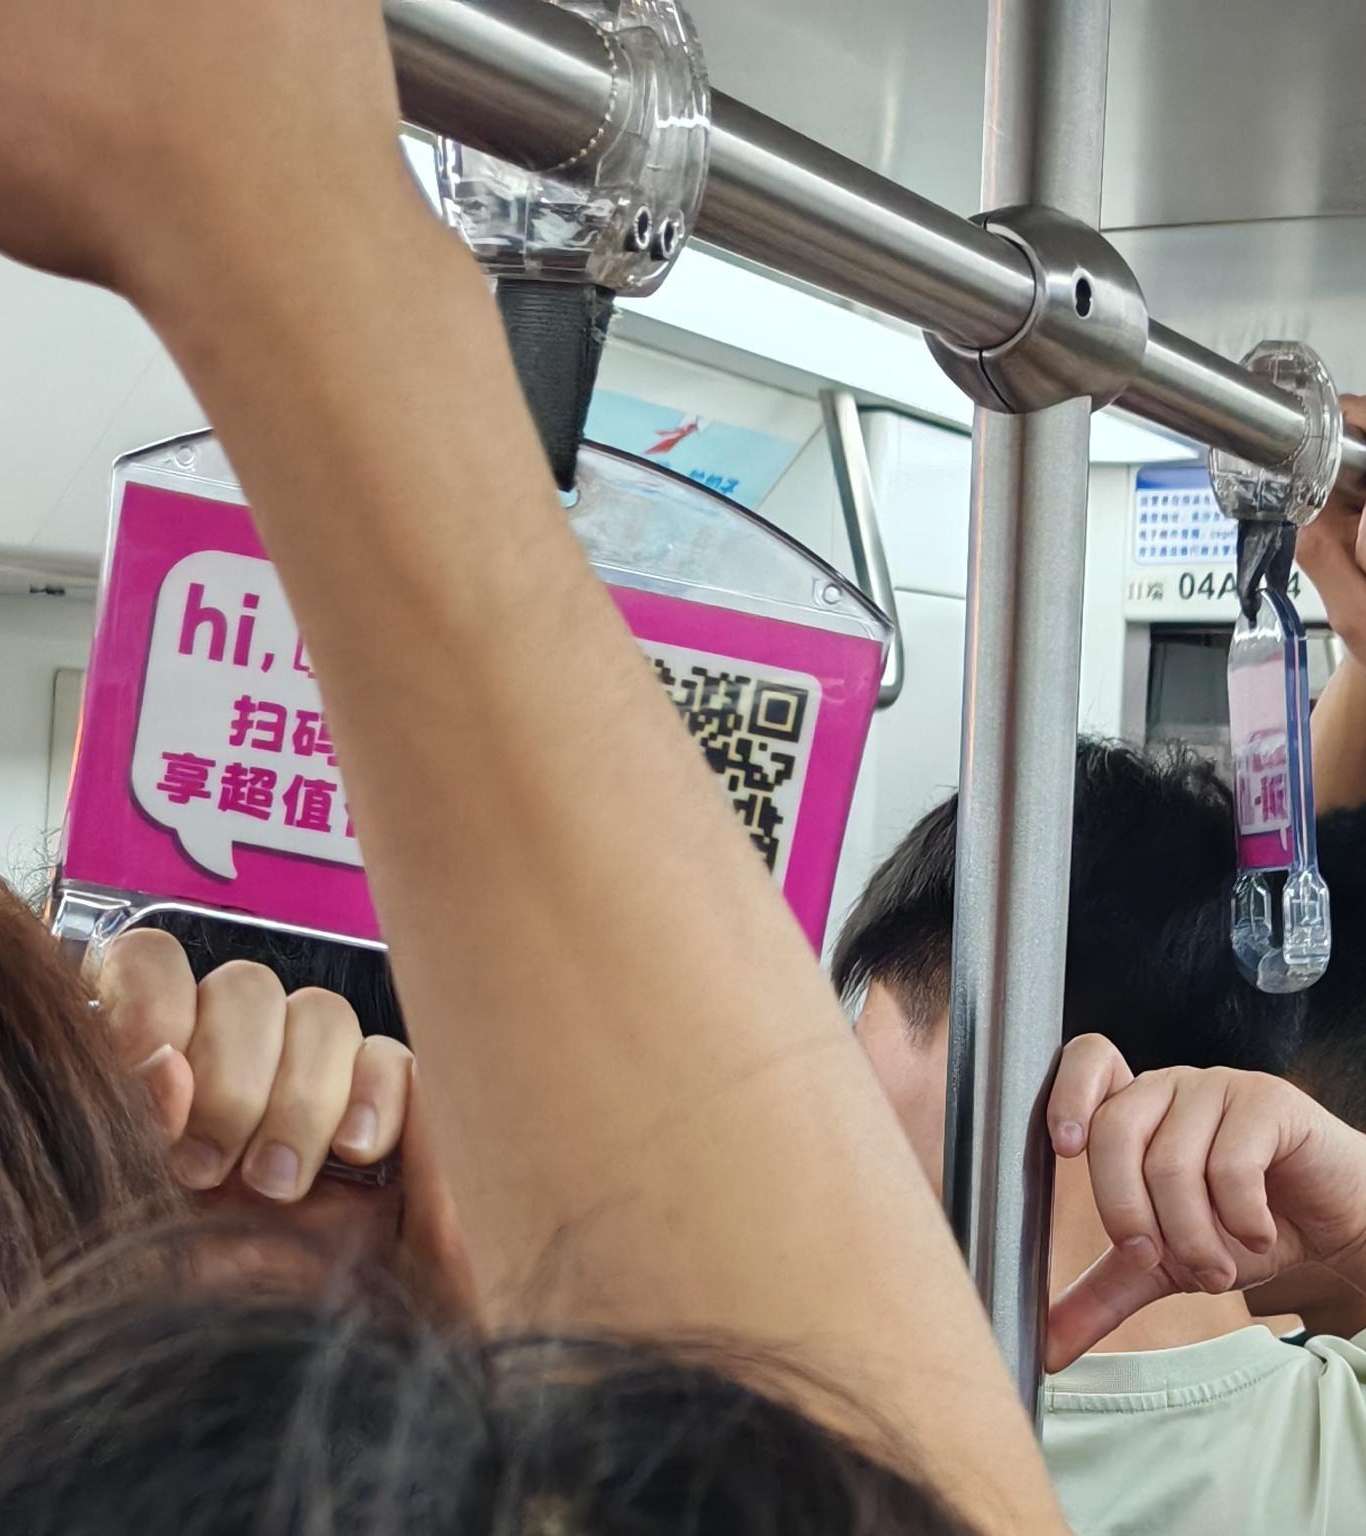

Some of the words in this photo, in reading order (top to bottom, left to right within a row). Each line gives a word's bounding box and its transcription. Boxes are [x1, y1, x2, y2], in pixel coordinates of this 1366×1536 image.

[178, 582, 276, 673] hi,
[156, 751, 357, 839] 享超值
